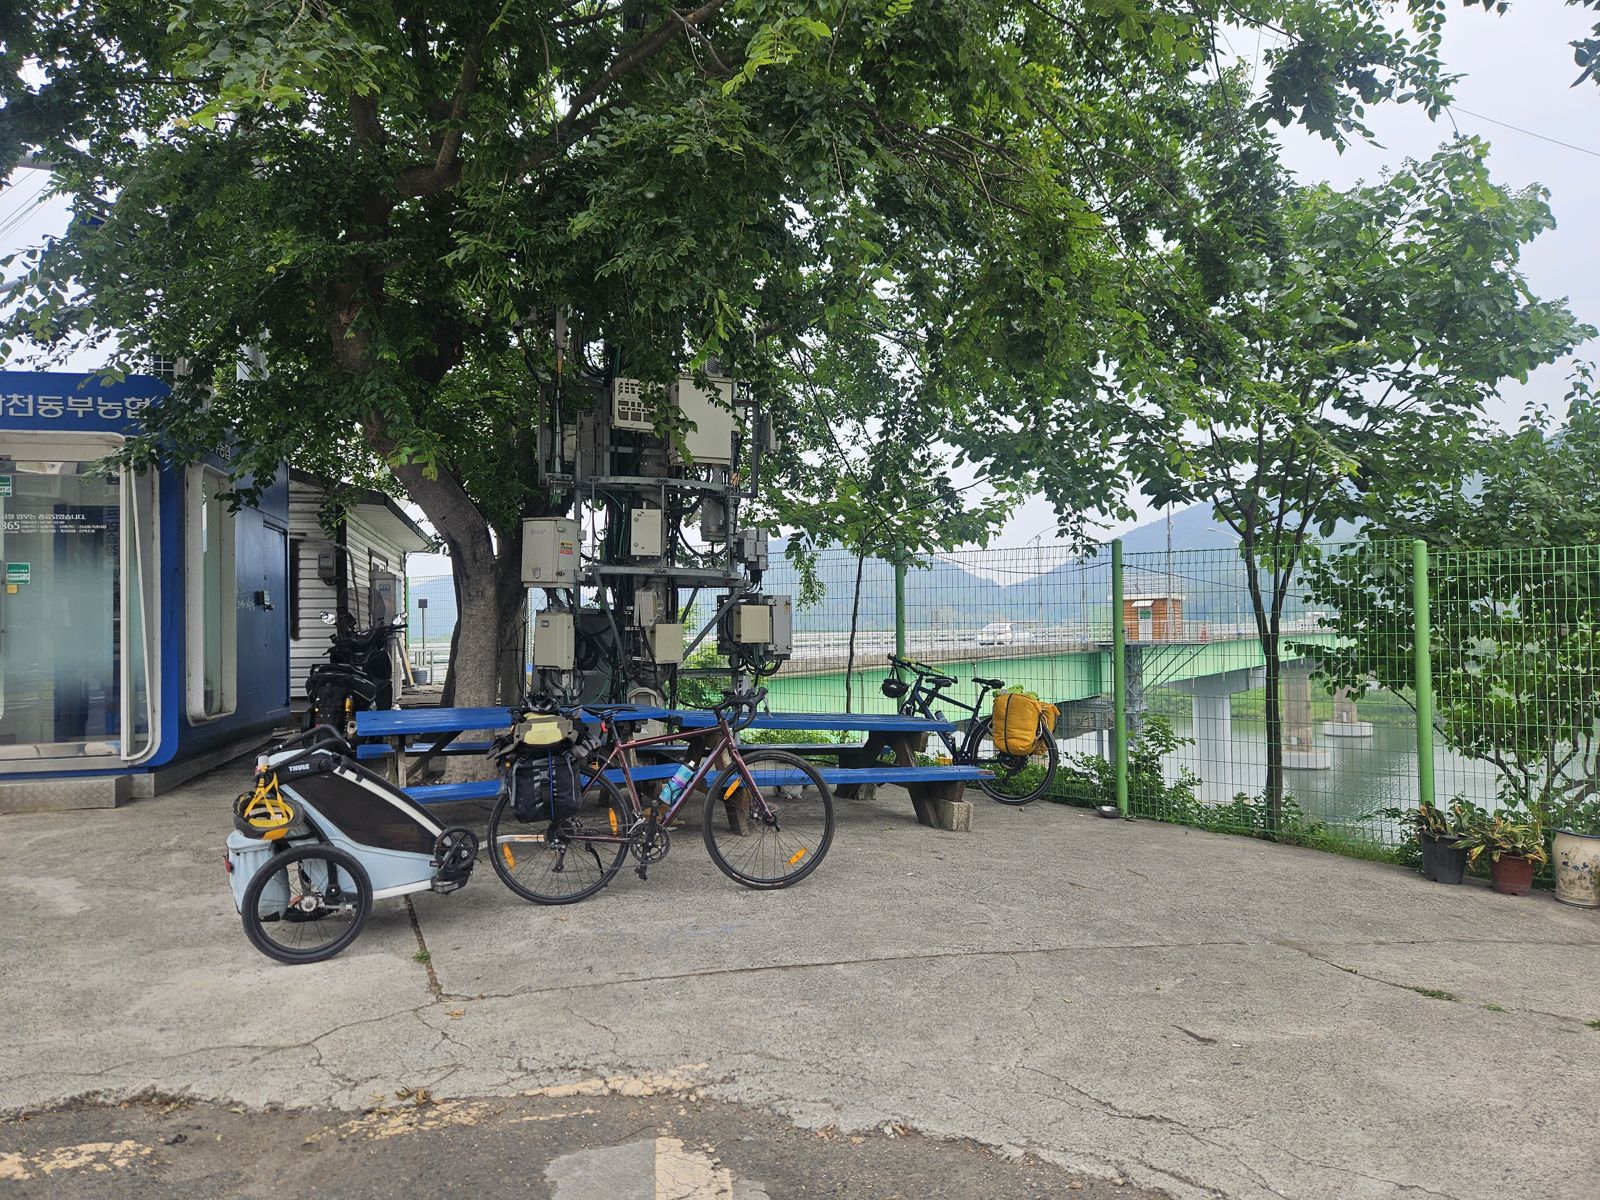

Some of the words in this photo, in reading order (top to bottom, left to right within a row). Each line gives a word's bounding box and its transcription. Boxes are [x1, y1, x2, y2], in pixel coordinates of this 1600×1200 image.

[0, 393, 150, 419] 천동부농협
[2, 521, 20, 530] 365
[288, 763, 310, 772] THULE
